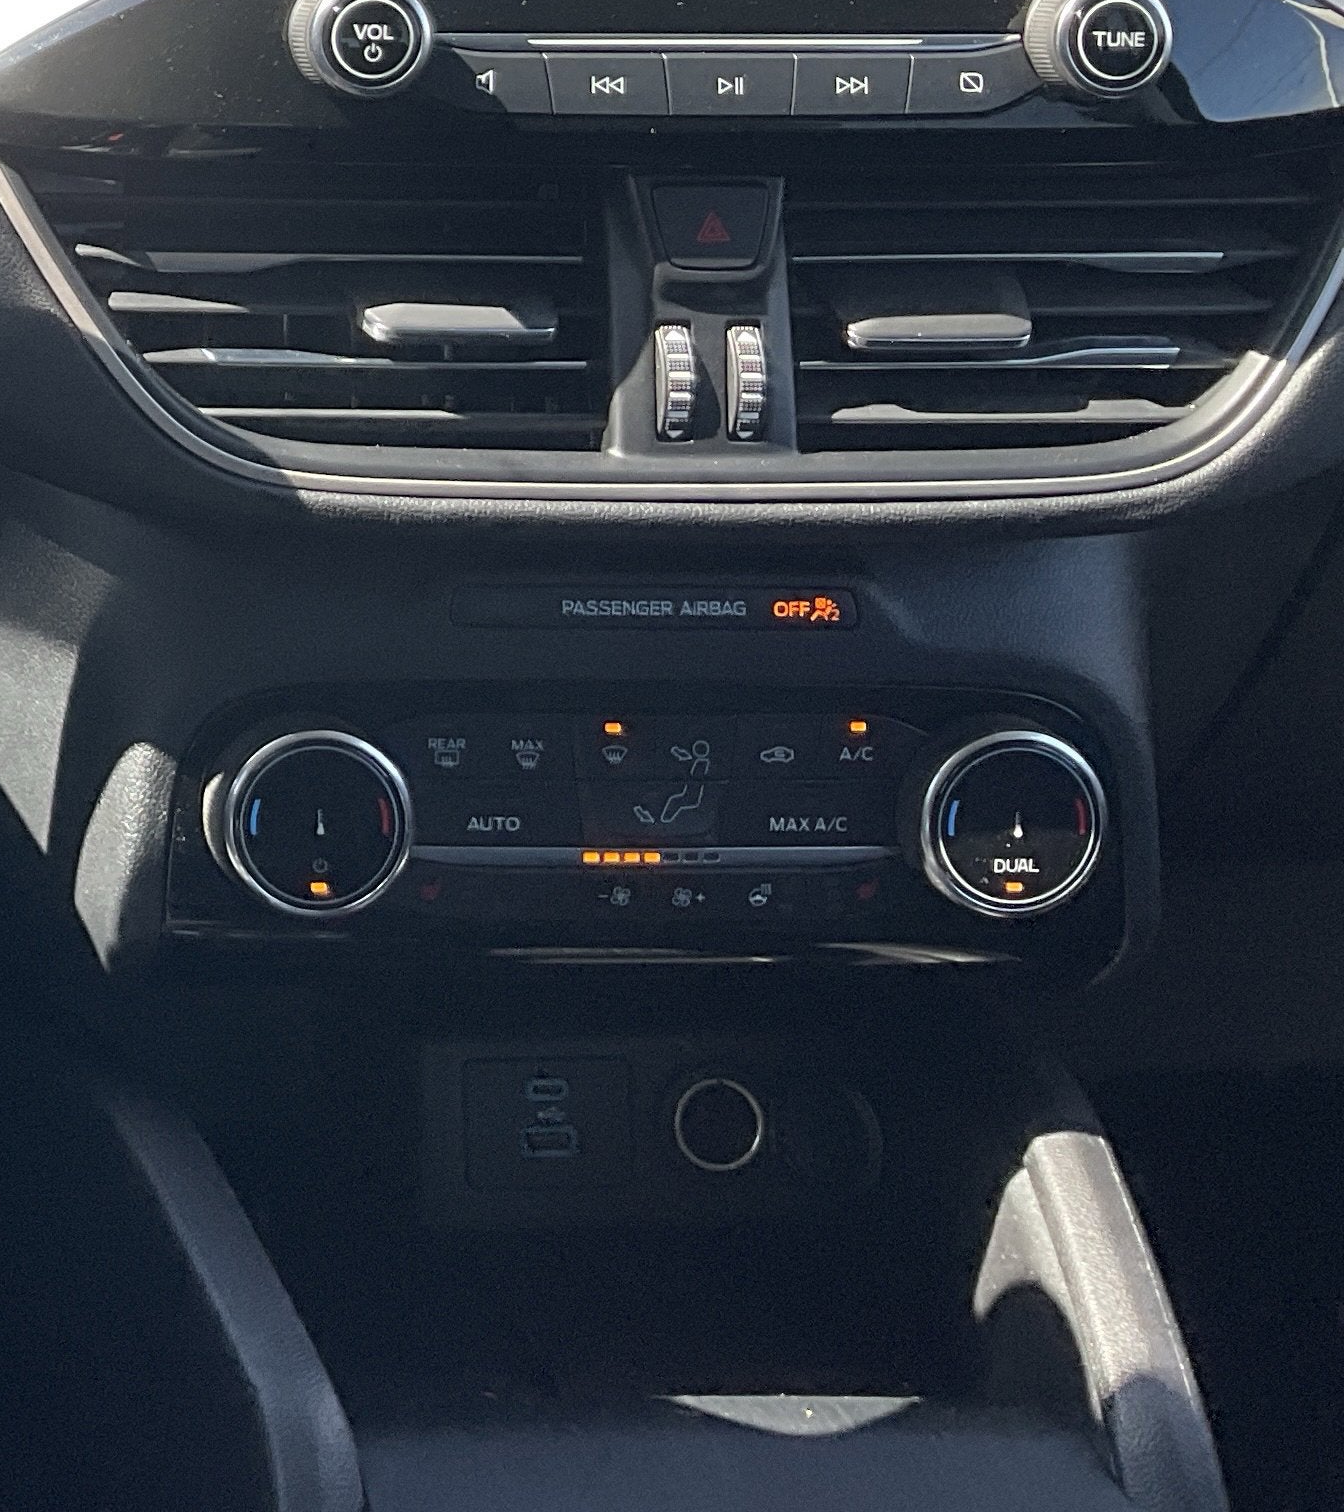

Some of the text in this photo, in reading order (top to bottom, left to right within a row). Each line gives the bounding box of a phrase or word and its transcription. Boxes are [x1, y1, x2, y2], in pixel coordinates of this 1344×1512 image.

[353, 23, 394, 40] VOL
[1092, 31, 1146, 47] TUNE
[562, 600, 746, 618] PASSENGER AIRBAG
[773, 601, 811, 617] OFF
[428, 738, 466, 749] REAR
[512, 740, 544, 750] MAX
[840, 747, 873, 761] A/C
[467, 817, 520, 832] AUTO
[769, 817, 848, 832] MAX A/C
[993, 858, 1039, 874] DUAL
